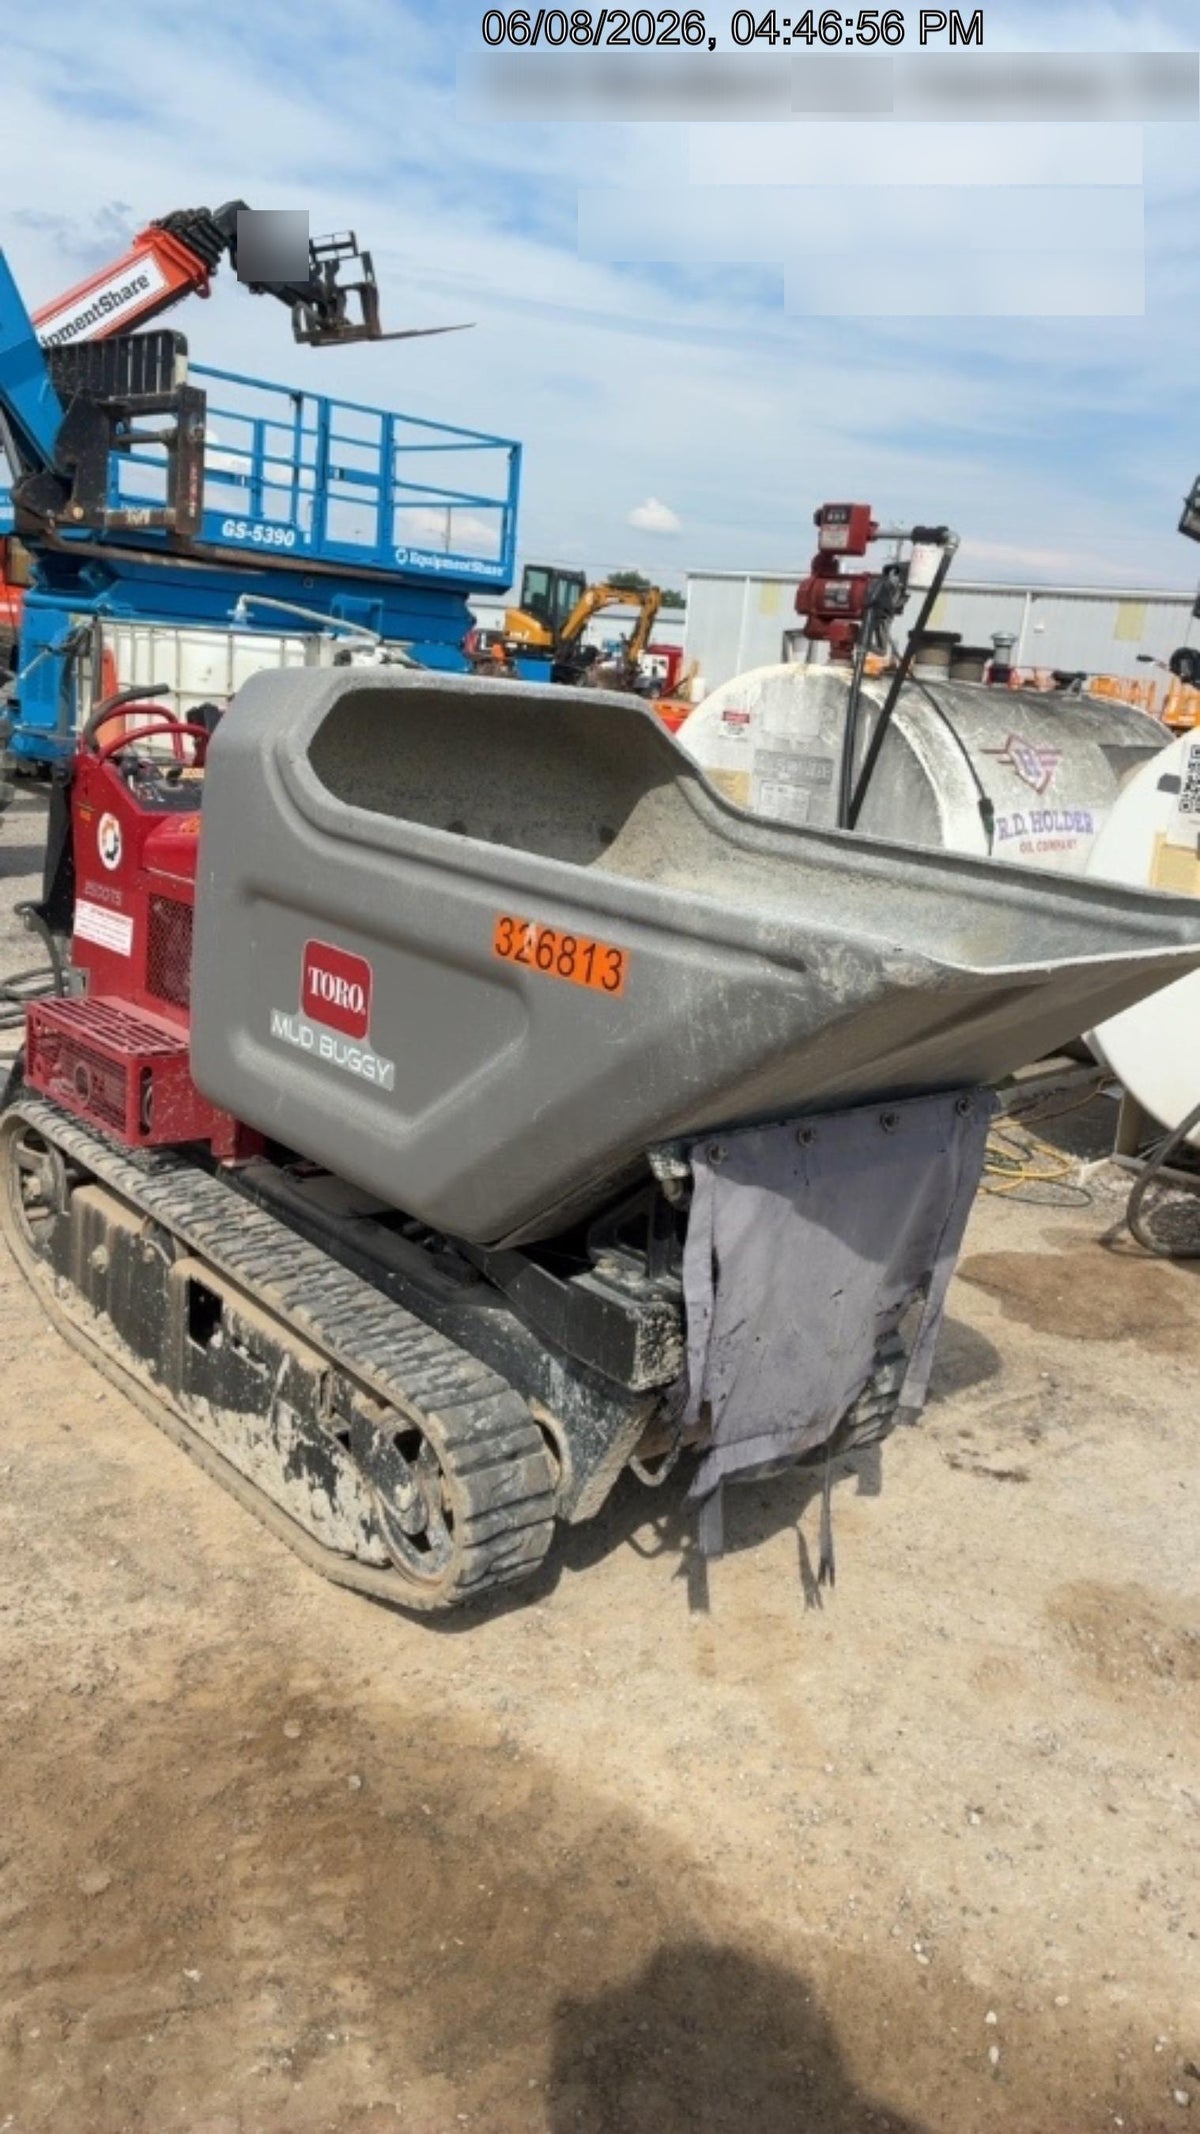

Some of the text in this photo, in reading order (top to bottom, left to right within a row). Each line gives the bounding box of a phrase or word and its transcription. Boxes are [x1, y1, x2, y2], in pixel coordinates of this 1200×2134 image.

[221, 519, 296, 546] GS-5390
[1029, 809, 1094, 835] HOLDER
[495, 917, 623, 991] 326813
[308, 966, 364, 1013] TORO
[271, 1014, 390, 1083] MUD BUGGY
